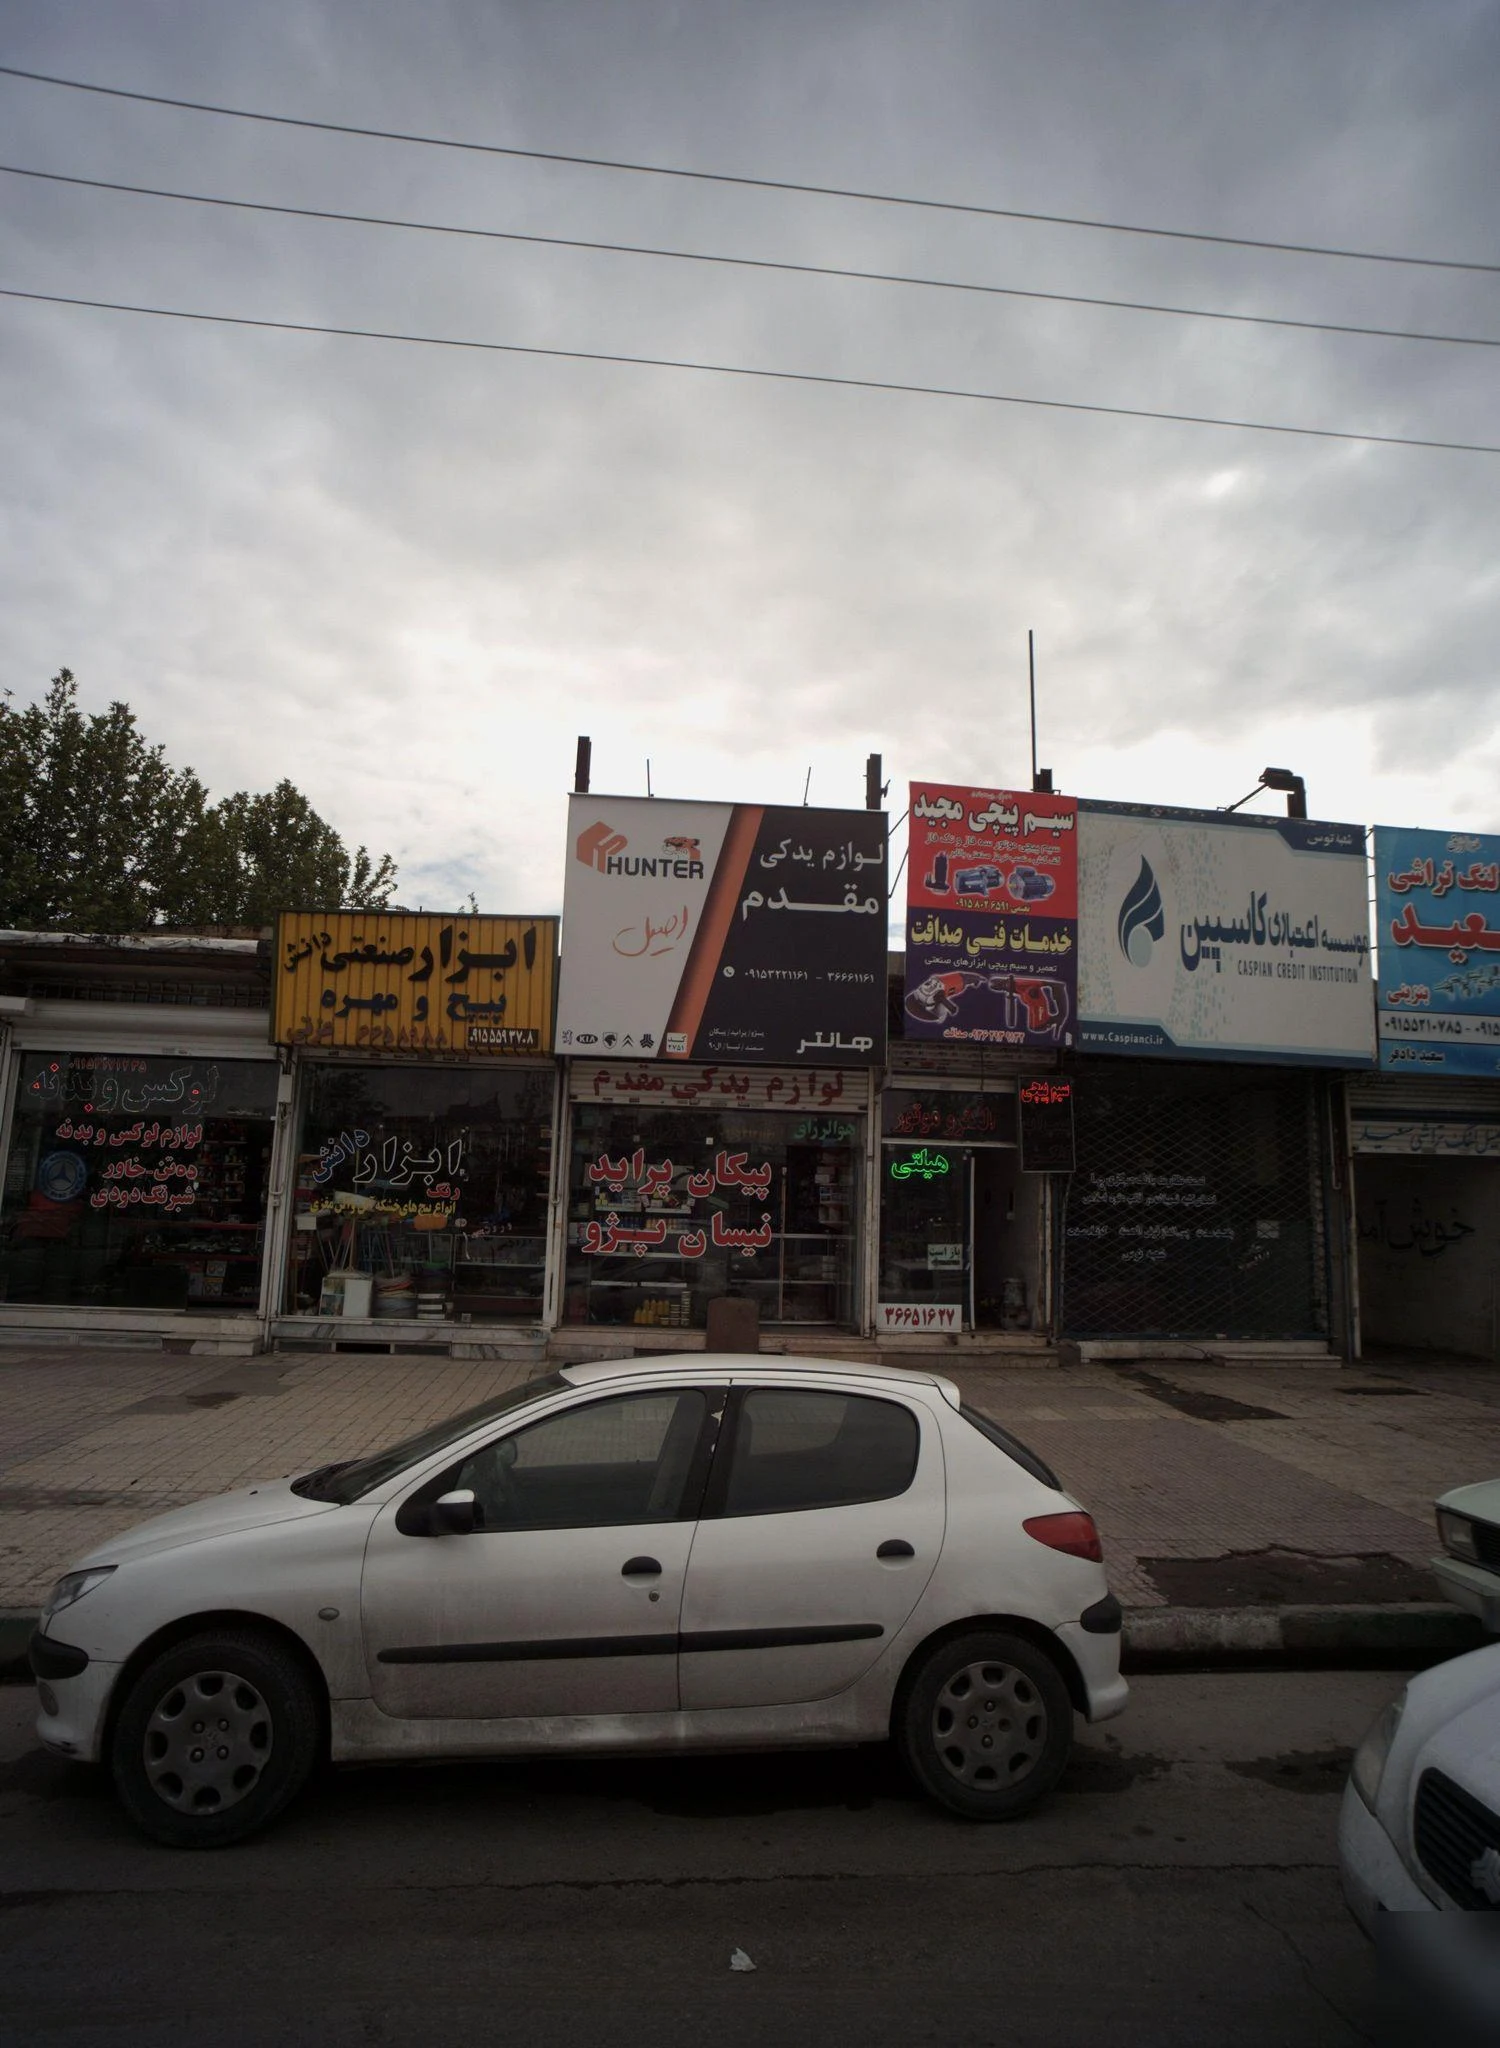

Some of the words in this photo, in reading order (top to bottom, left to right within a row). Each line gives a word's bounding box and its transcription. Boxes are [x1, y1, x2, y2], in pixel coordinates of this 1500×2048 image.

[913, 792, 964, 829] مجید
[968, 801, 1020, 838] پیچی
[1023, 811, 1075, 838] سیم
[606, 855, 704, 880] HUNTER
[759, 838, 815, 868] یدکی
[822, 842, 885, 872] لوازم
[1387, 856, 1455, 897] تراشی
[741, 884, 880, 922] مقدم
[612, 905, 689, 958] اصیل
[911, 914, 964, 945] صداقت
[966, 920, 1006, 956] فنی
[1009, 923, 1073, 954] خدمات
[1180, 891, 1267, 973] کاسپین
[1268, 911, 1320, 958] اعتباری
[1321, 927, 1369, 966] موسسه
[1389, 902, 1500, 964] عید
[284, 931, 332, 973] دانش
[320, 935, 415, 973] صنعتی
[408, 924, 537, 984] ابزار
[924, 955, 952, 966] صنعتی
[1237, 959, 1273, 978] CASPIAN
[1277, 962, 1306, 980] CREDIT
[1309, 965, 1359, 984] INSTITUTION
[321, 989, 399, 1018] مهره
[412, 994, 429, 1022] و
[446, 991, 507, 1024] پیچ
[578, 1035, 597, 1043] KIA
[796, 1031, 873, 1054] هانتر
[1475, 1021, 1500, 1036] ۰۹۱۵
[592, 1063, 665, 1097] مقدم
[671, 1067, 751, 1101] یدکی
[766, 1070, 844, 1106] لوازم
[1019, 1080, 1050, 1104] پیچی
[1050, 1083, 1071, 1104] سیم
[55, 1117, 95, 1146] بدنه
[94, 1128, 107, 1146] و
[108, 1121, 161, 1148] لوکس
[160, 1123, 204, 1149] لوازم
[312, 1128, 370, 1184] دانش
[352, 1135, 463, 1187] ابزار
[588, 1147, 674, 1198] پراید
[890, 1148, 950, 1180] هیلتی
[426, 1182, 461, 1201] رنگ
[687, 1150, 773, 1202] پیکان
[581, 1211, 668, 1258] پژو
[678, 1210, 773, 1259] نیسان
[1386, 1196, 1476, 1259] خوش
